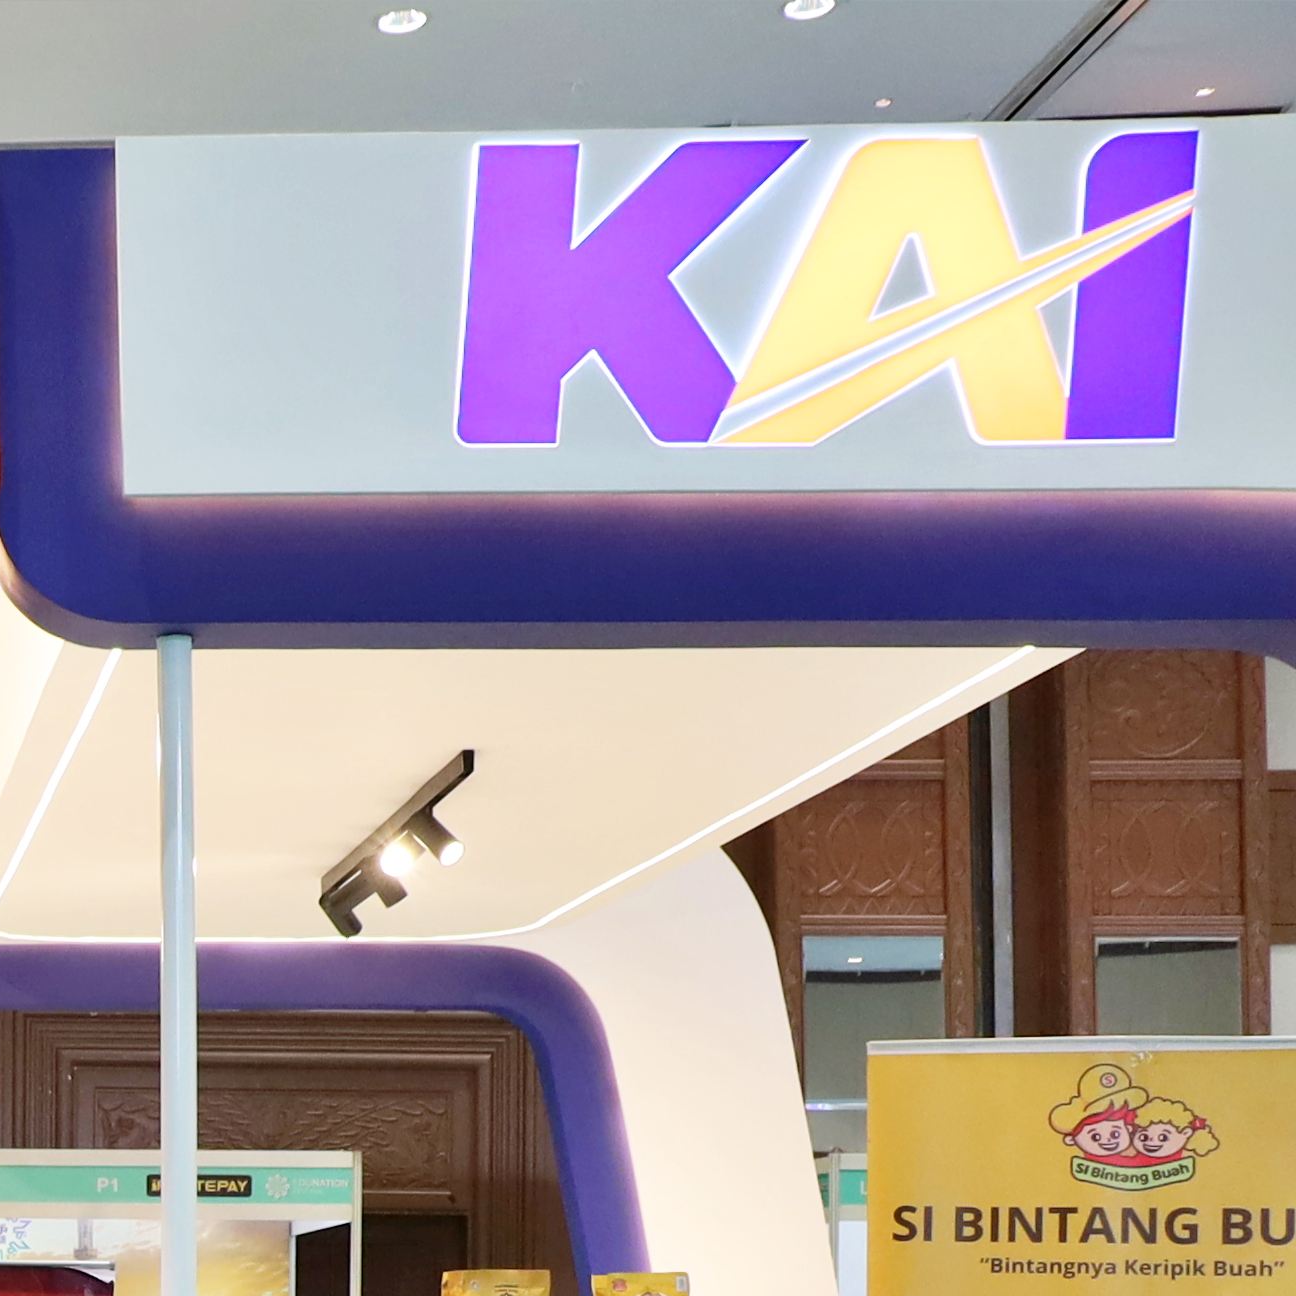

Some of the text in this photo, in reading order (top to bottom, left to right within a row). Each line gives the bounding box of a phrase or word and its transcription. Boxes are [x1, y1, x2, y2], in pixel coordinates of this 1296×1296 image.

[454, 130, 1199, 447] KAI
[96, 1177, 119, 1192] P1
[1091, 1164, 1190, 1185] Bintang Buah
[892, 1205, 1296, 1246] SI BINTANG BU
[1124, 1258, 1206, 1281] Keripik
